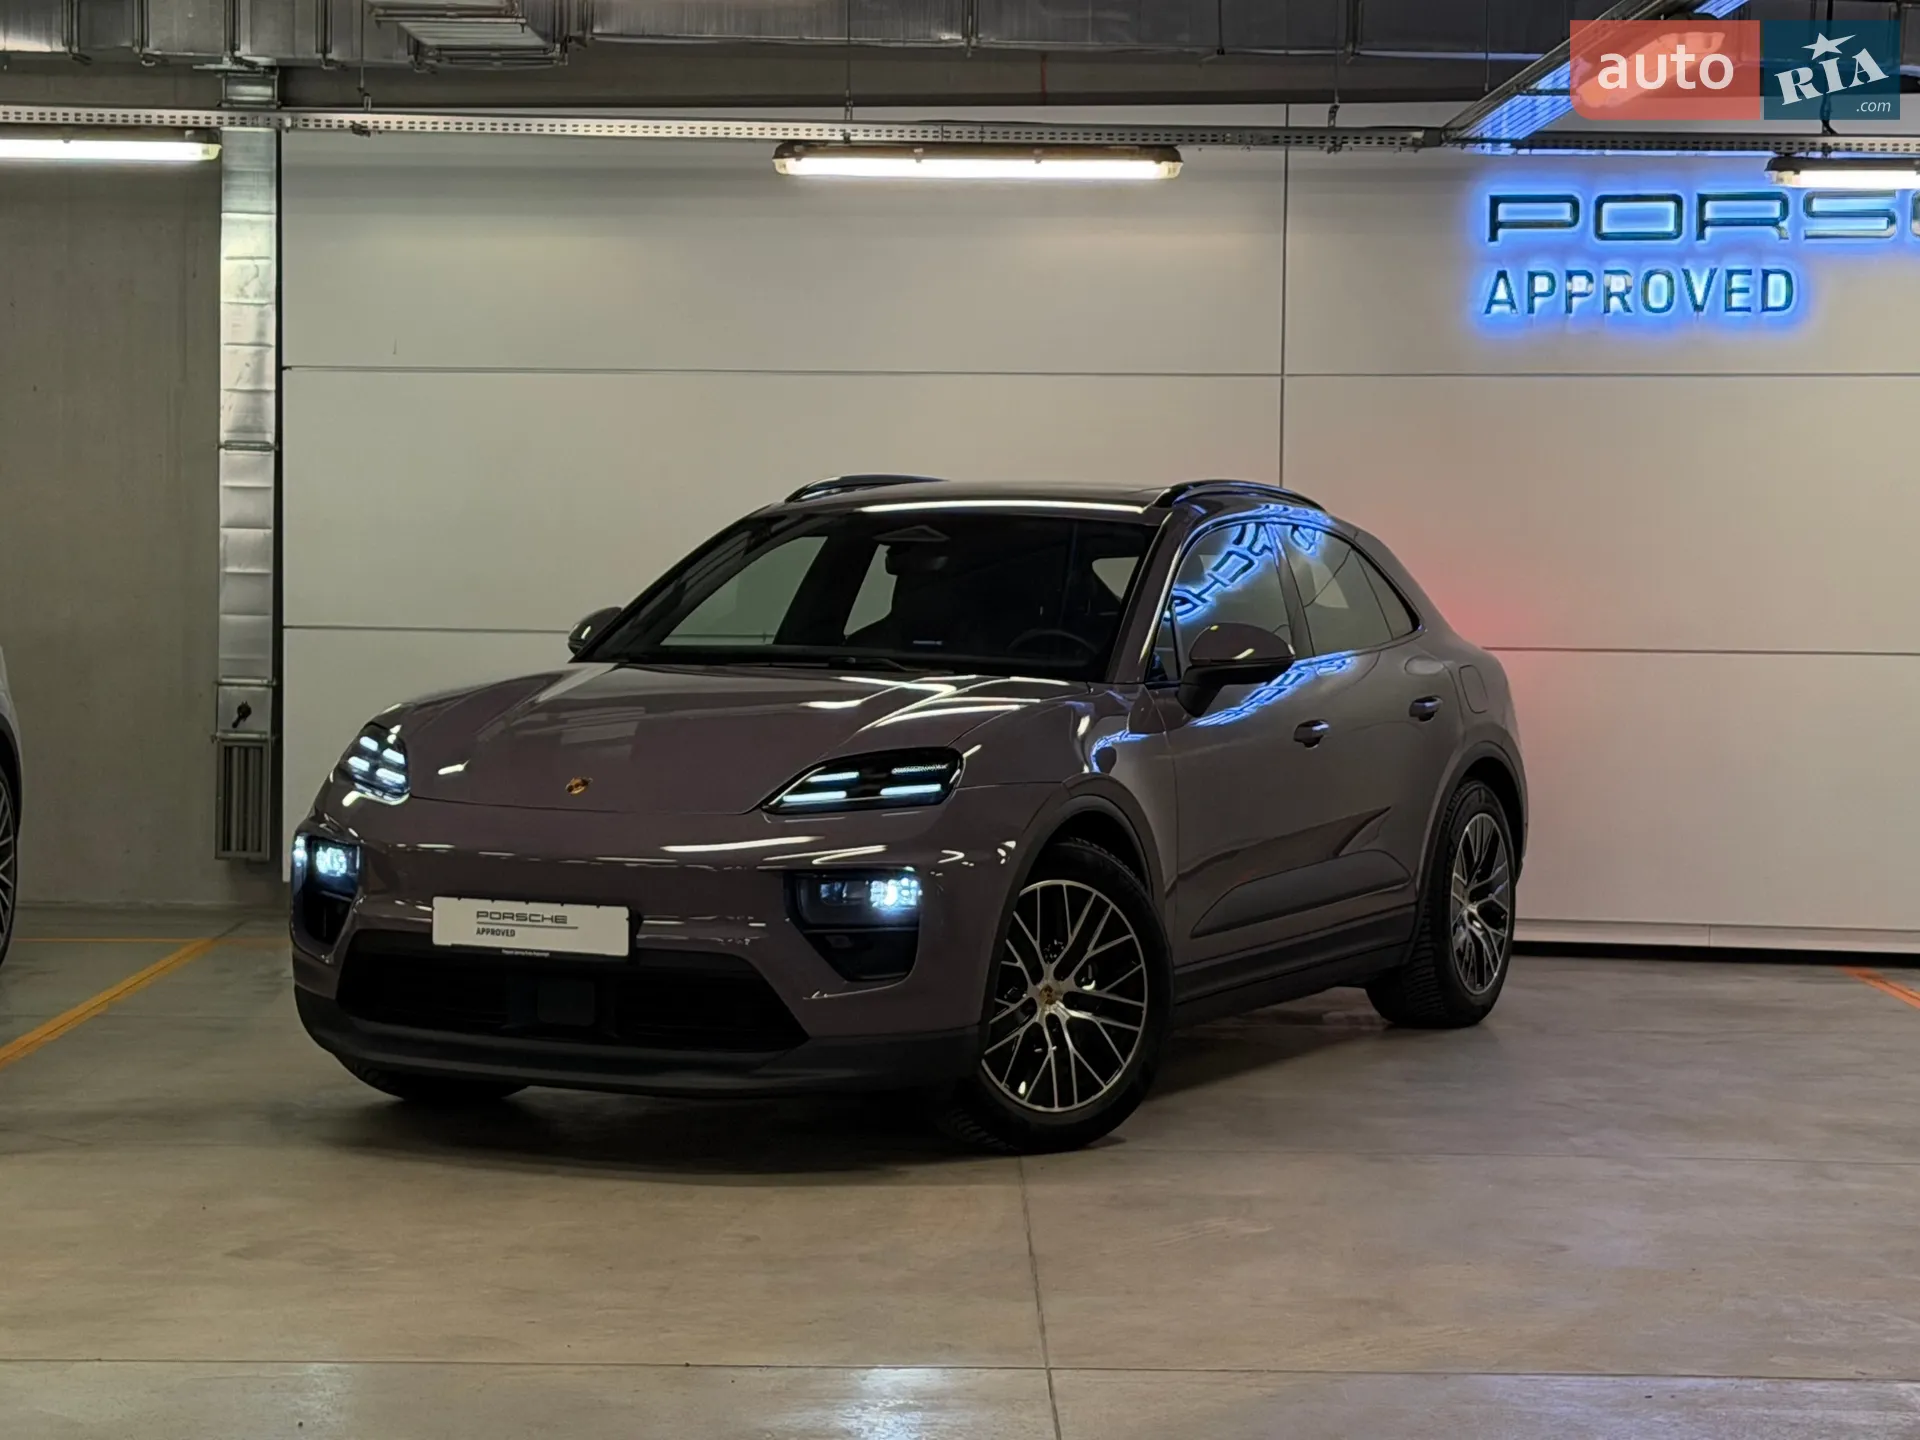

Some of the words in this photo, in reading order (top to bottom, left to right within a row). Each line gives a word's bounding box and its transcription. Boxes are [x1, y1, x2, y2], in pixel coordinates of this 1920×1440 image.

[1487, 191, 1920, 243] PORS
[1484, 267, 1794, 315] APPROVED
[476, 910, 568, 924] PORSCHE
[476, 927, 516, 938] APPROVED
